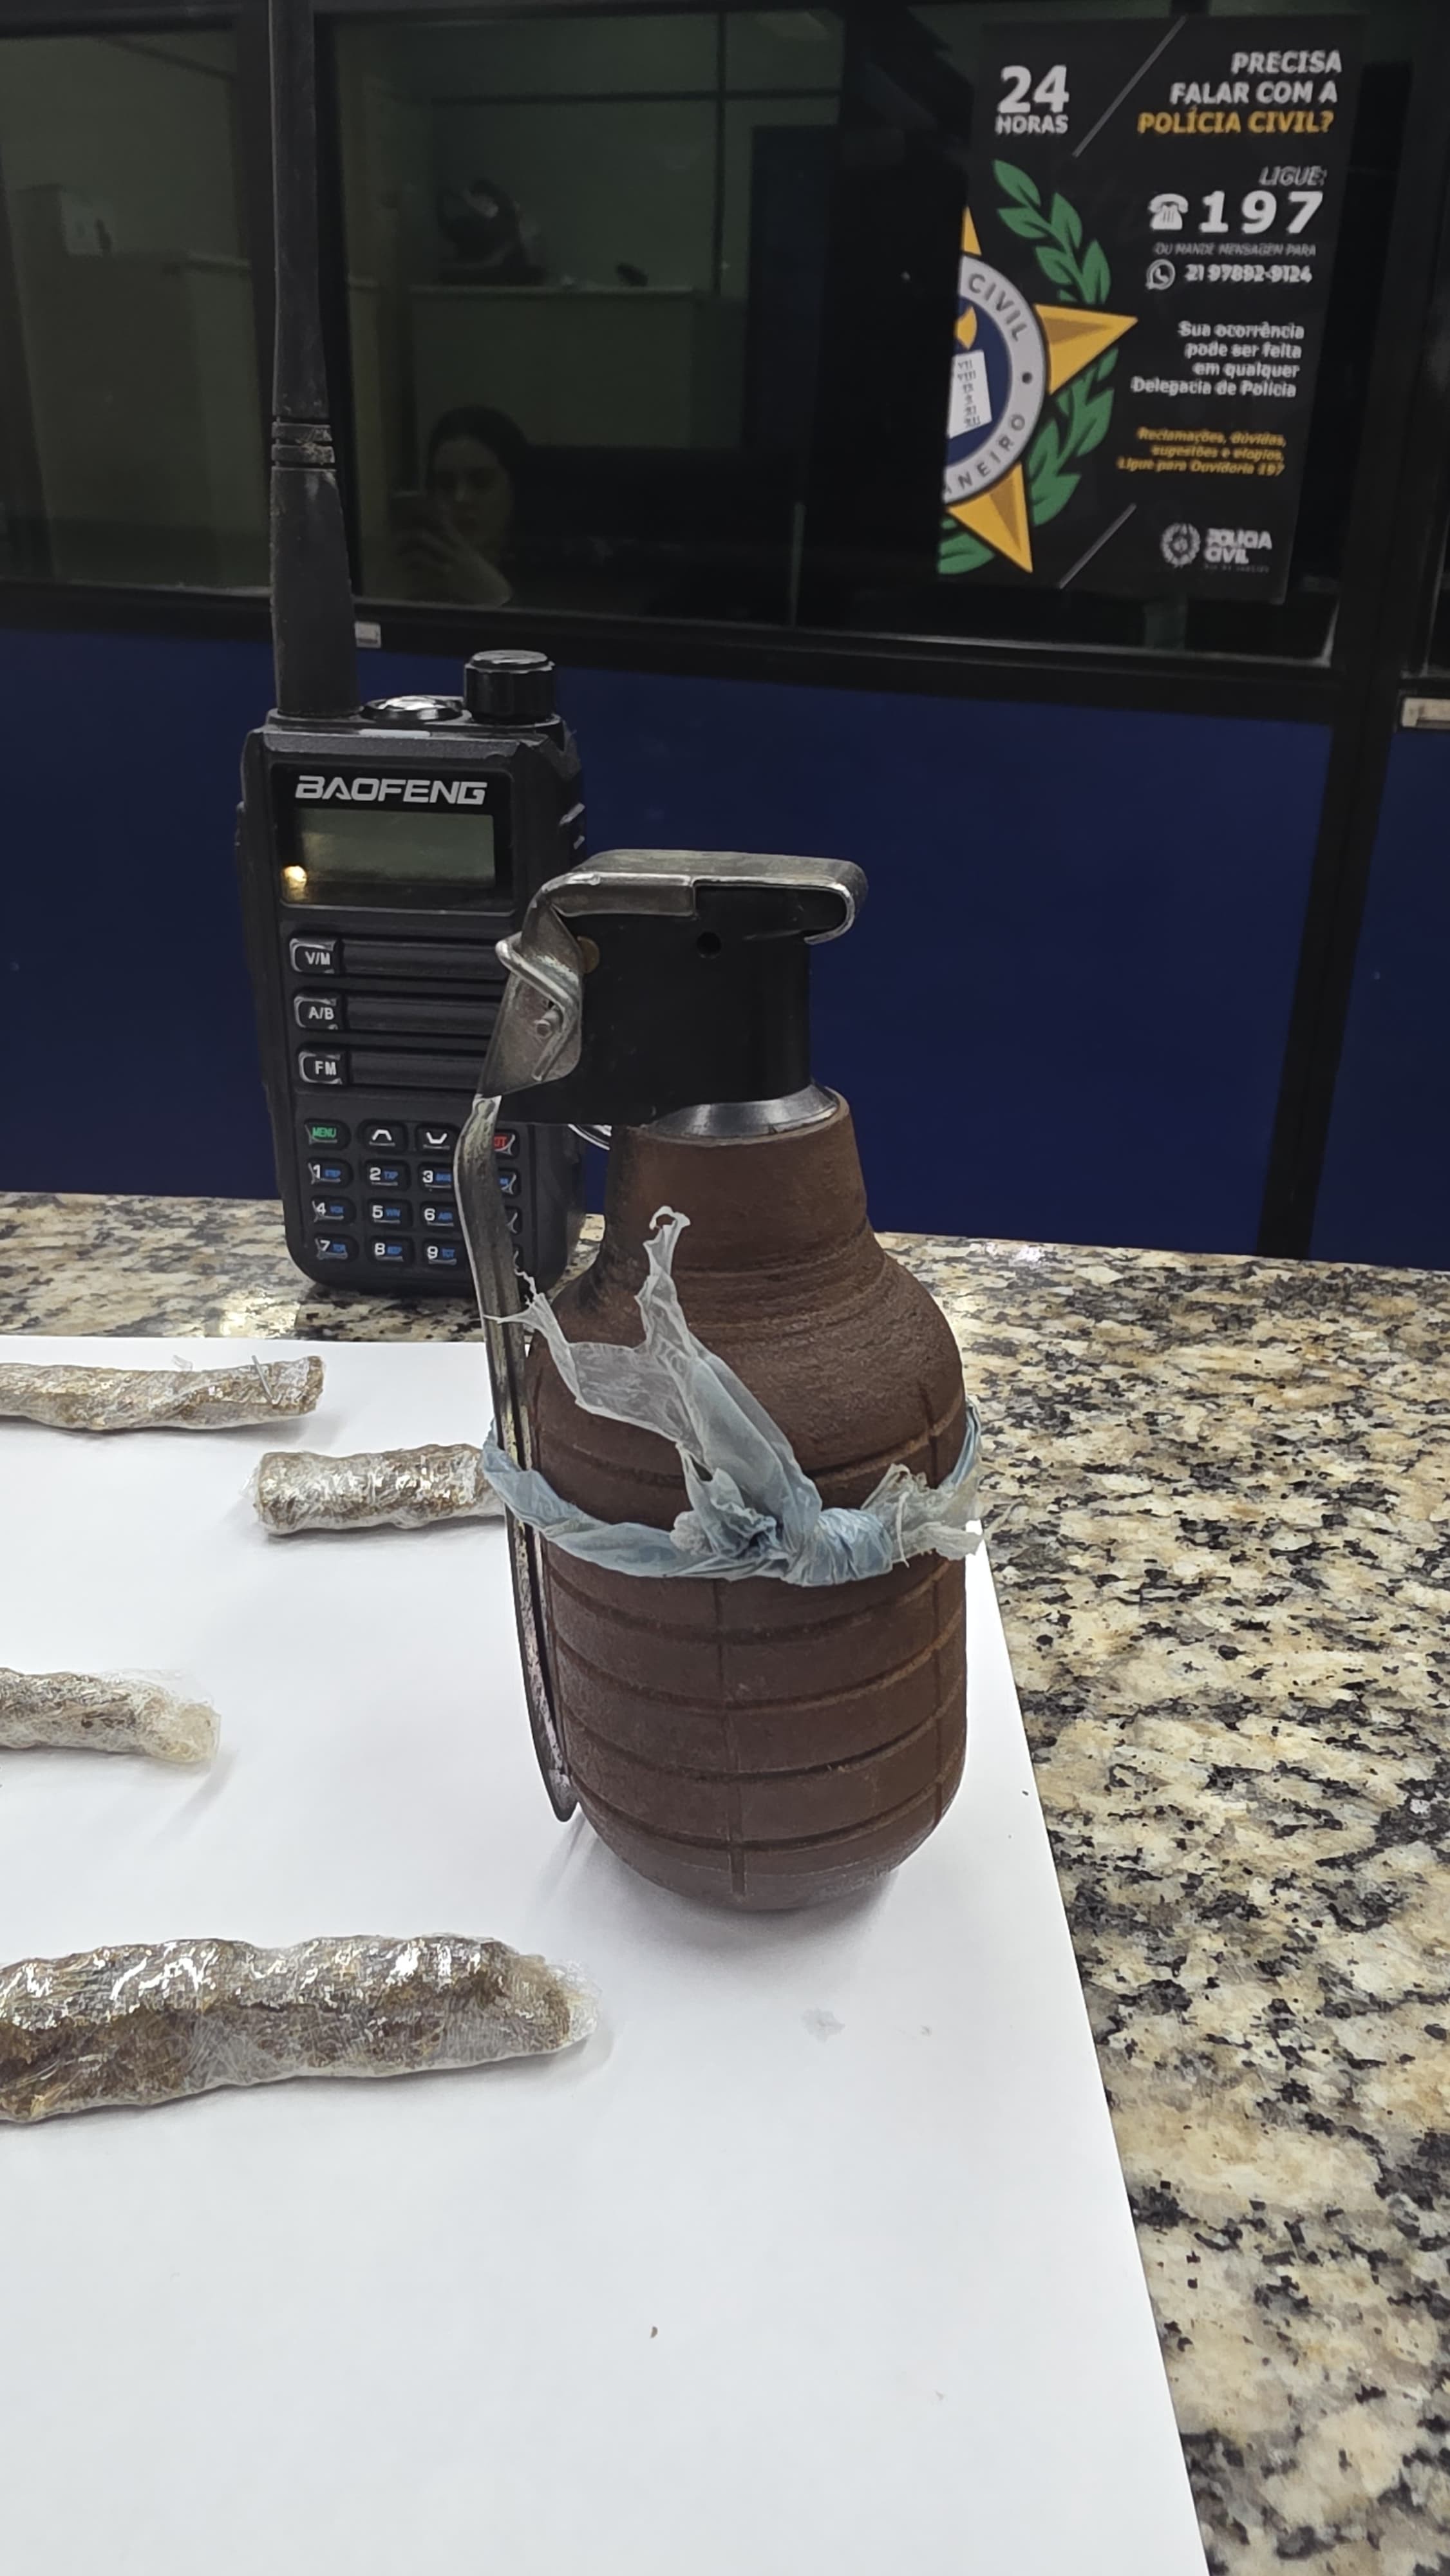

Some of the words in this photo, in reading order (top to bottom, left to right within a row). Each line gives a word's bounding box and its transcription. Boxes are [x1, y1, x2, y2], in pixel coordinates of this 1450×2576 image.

[1230, 50, 1342, 74] PRECISA
[997, 64, 1069, 113] 24
[1170, 81, 1250, 104] FALAR
[1256, 80, 1313, 104] COM
[1318, 80, 1338, 102] A
[995, 114, 1069, 134] HORAS
[1138, 105, 1241, 133] POLÍCIA
[1247, 111, 1334, 133] CIVIL?
[1198, 191, 1323, 234] 197
[1154, 242, 1172, 255] OU
[1174, 242, 1215, 256] MANDE
[1285, 243, 1316, 256] PARA
[968, 273, 1028, 342] CIVIL
[1178, 321, 1211, 337] Sua
[1214, 322, 1305, 340] ocorrência
[1184, 341, 1229, 359] pode
[1230, 344, 1259, 357] ser
[1262, 341, 1303, 359] feita
[1192, 362, 1221, 376] em
[1223, 361, 1301, 380] qualquer
[1131, 376, 1212, 397] Delegacia
[1214, 379, 1237, 395] de
[295, 775, 487, 805] BAOFENG
[305, 951, 330, 965] V/M
[308, 1006, 335, 1020] A/B
[315, 1061, 337, 1075] FM
[312, 1126, 337, 1139] MENU
[313, 1164, 321, 1179] 1
[370, 1167, 382, 1181] 2
[422, 1170, 434, 1184] 3
[315, 1202, 326, 1215] 4
[372, 1204, 384, 1219] 5
[424, 1208, 436, 1222] 6
[319, 1240, 331, 1252] 7
[374, 1242, 386, 1256] 8
[426, 1245, 438, 1259] 9
